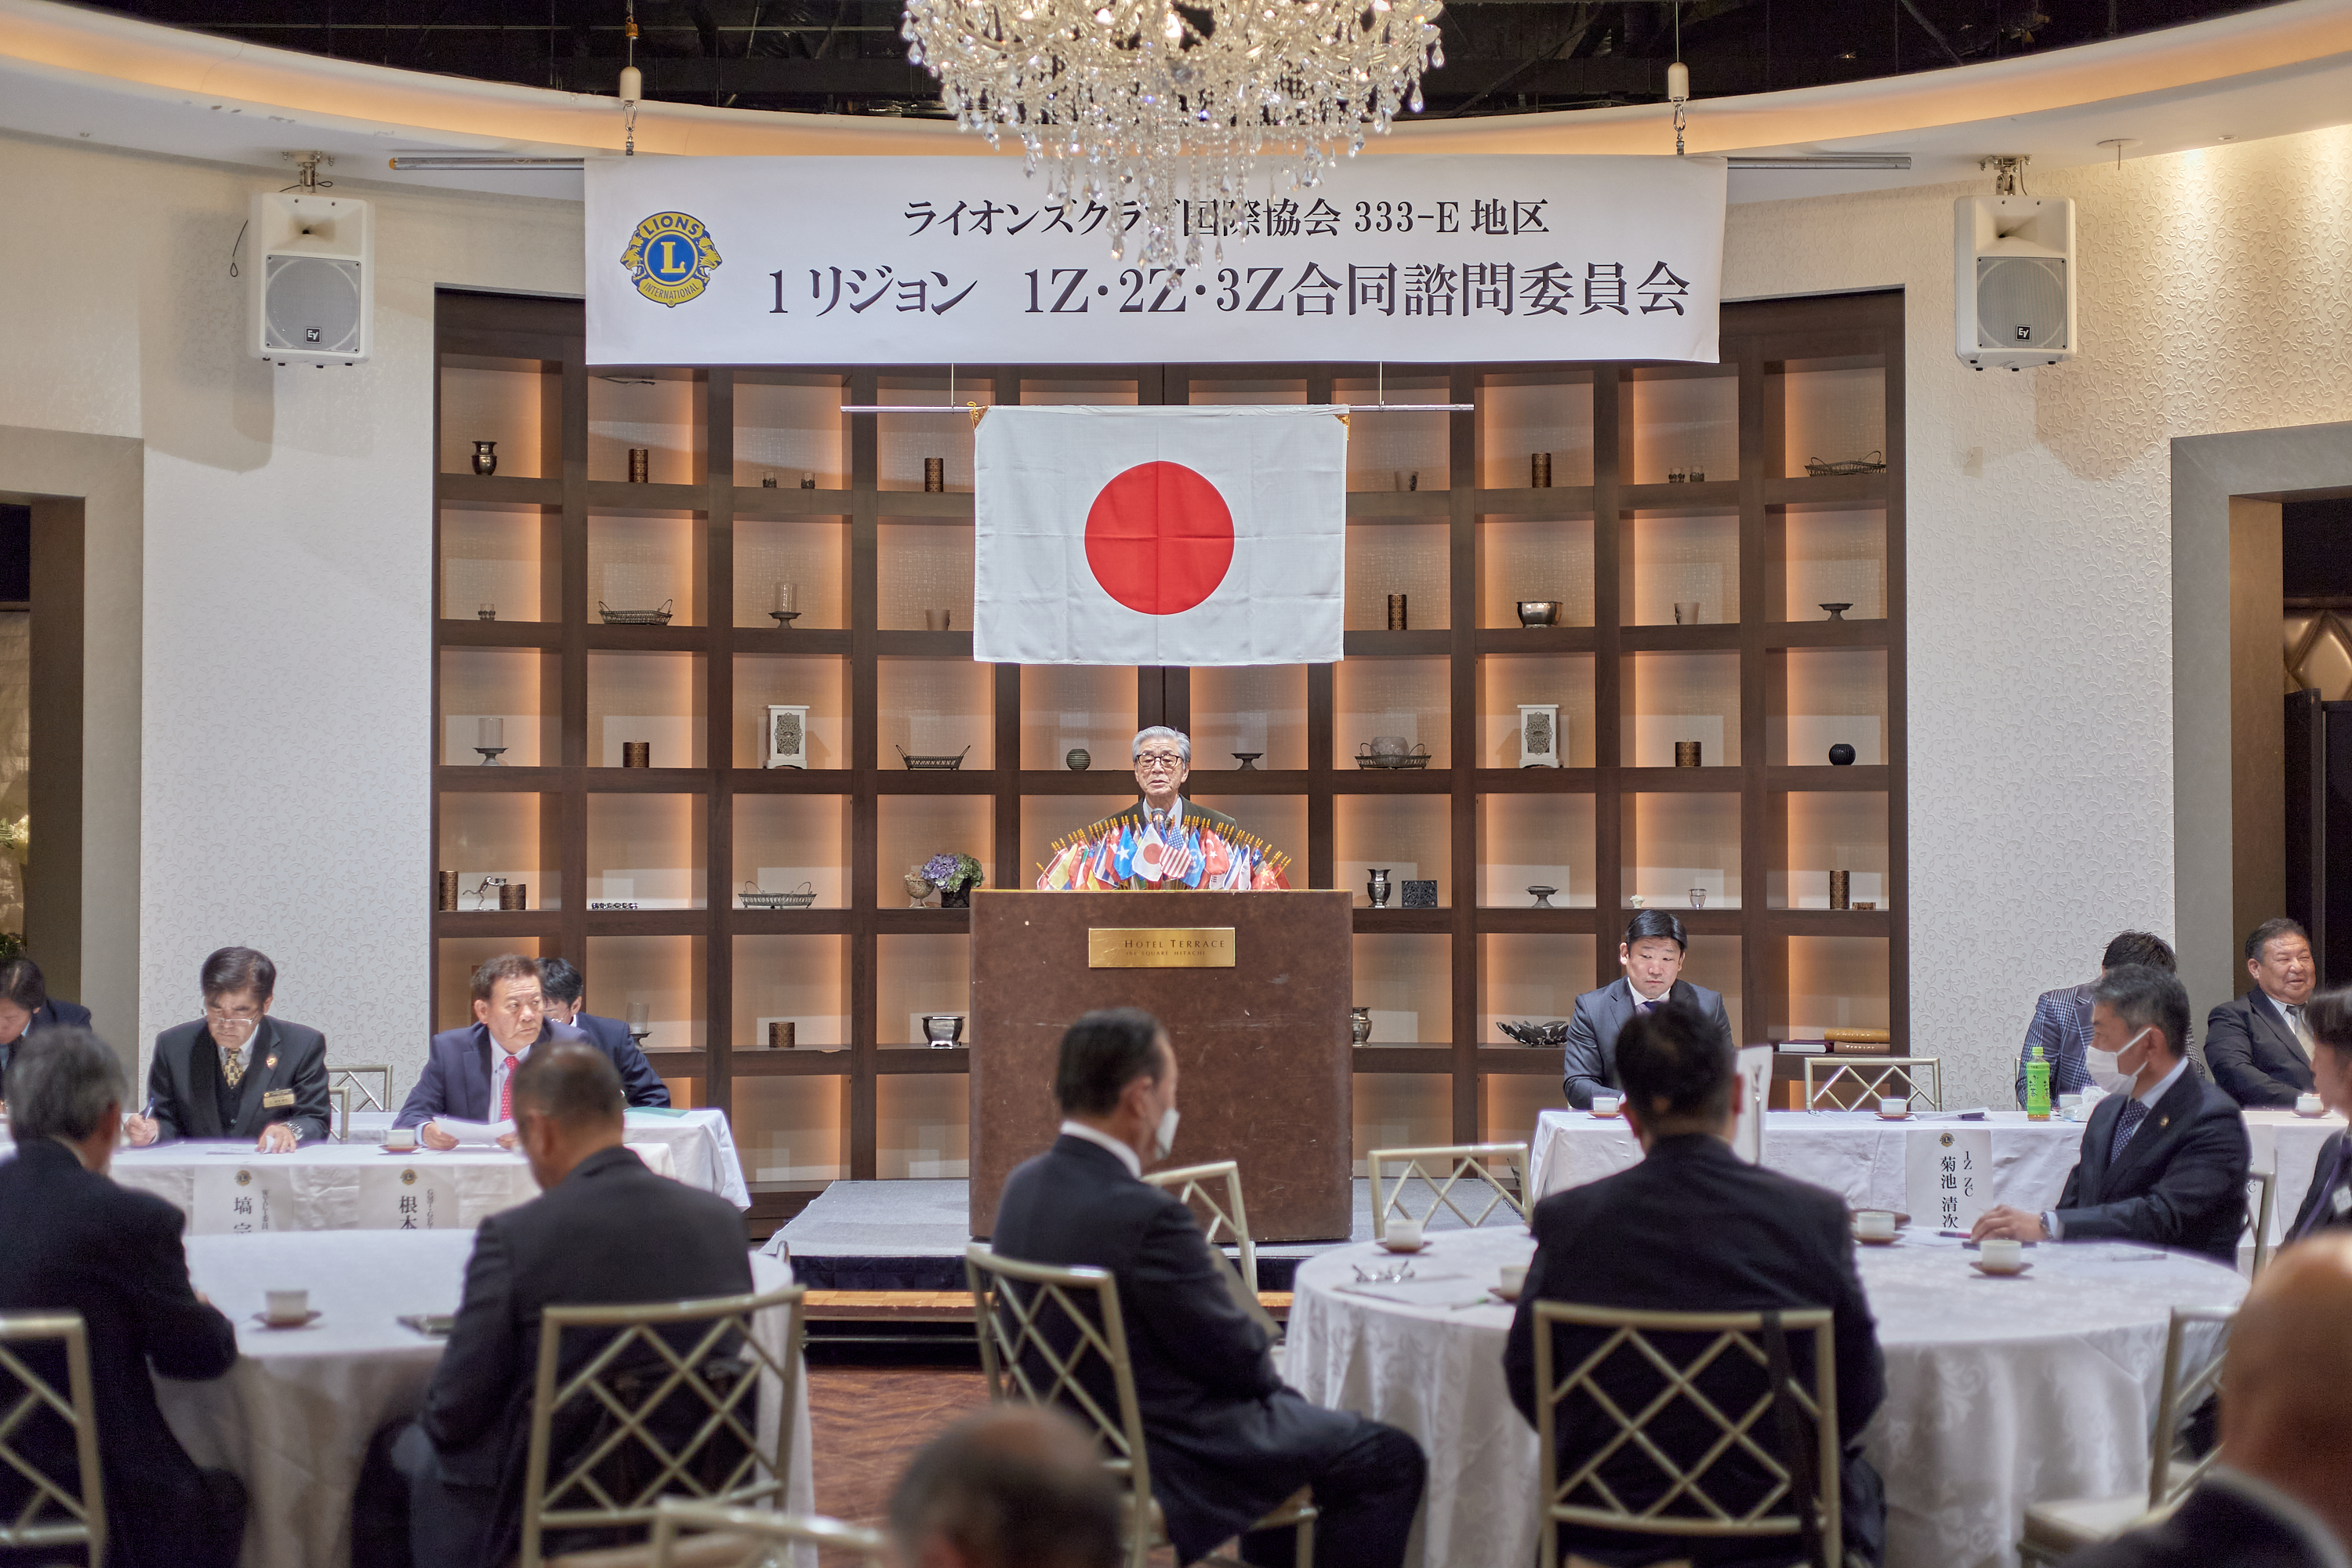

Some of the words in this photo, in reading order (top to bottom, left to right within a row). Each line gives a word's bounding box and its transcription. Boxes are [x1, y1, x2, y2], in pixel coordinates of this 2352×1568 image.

[642, 215, 700, 236] LIONS
[1355, 201, 1459, 233] 333-E
[1470, 198, 1550, 236] 地区
[660, 241, 686, 274] L
[642, 282, 700, 299] INTERNATIONAL
[1124, 939, 1163, 949] HOTEL
[1170, 939, 1225, 949] TERRACE
